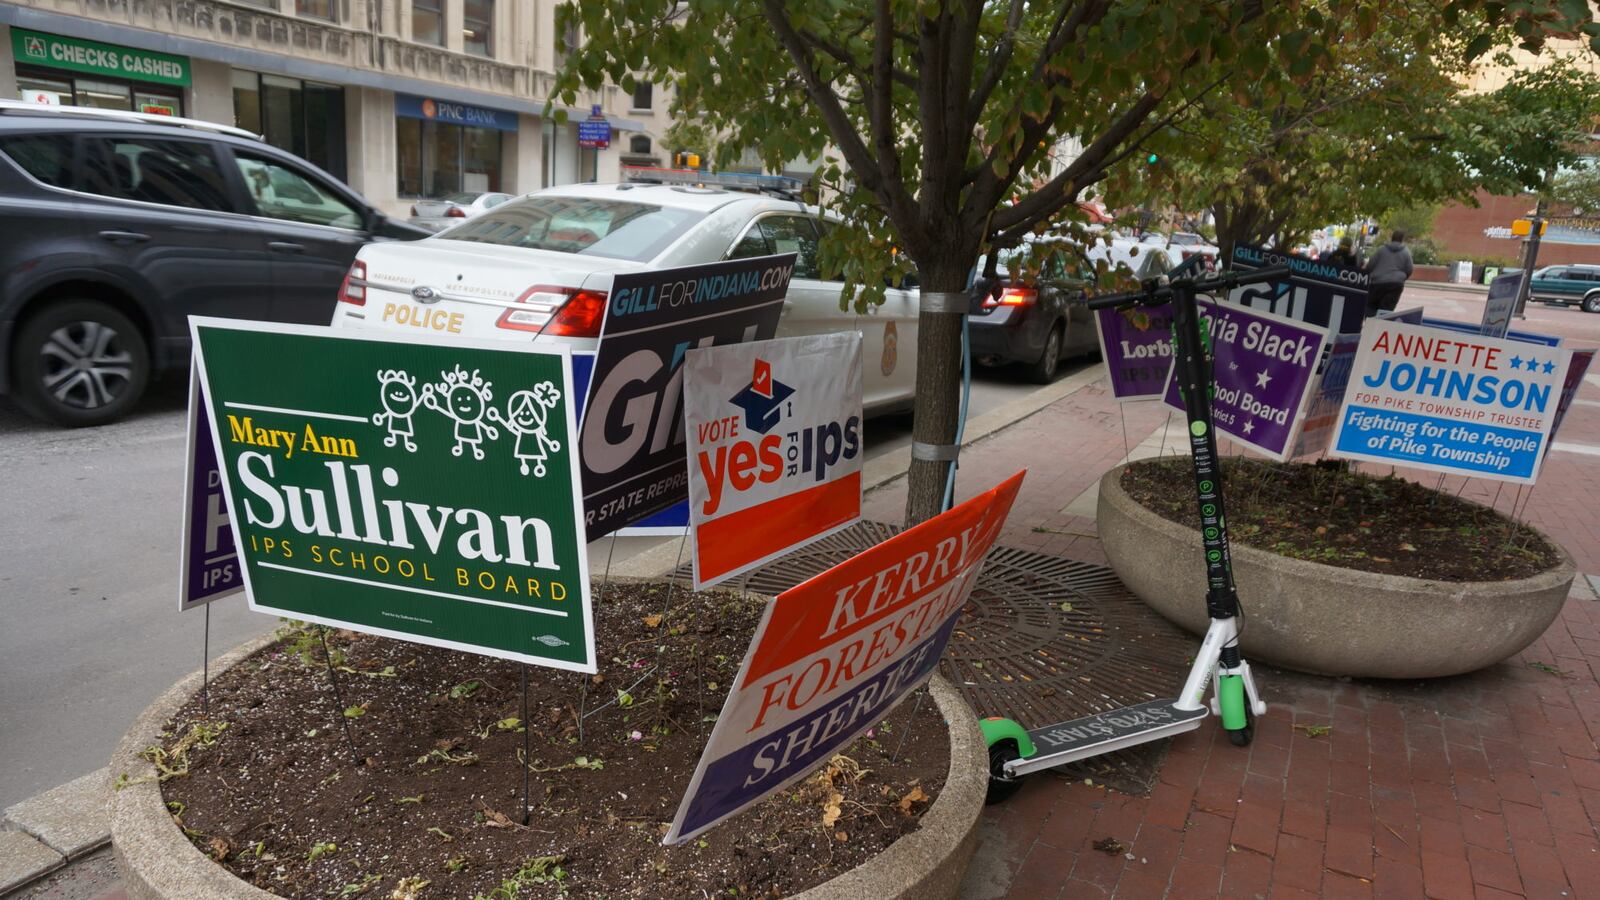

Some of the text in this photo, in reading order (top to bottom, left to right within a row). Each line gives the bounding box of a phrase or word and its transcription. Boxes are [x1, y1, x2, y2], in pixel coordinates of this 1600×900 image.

[51, 42, 183, 79] CHECKS CASHED
[438, 102, 497, 124] PNC BANK
[382, 303, 464, 334] POLICE
[1243, 321, 1313, 368] Slack
[1372, 331, 1502, 370] ANNETTE
[1214, 380, 1290, 425] hool Board
[1363, 360, 1551, 413] JOHNSON
[698, 415, 739, 445] VOTE
[1229, 414, 1236, 425] 5
[1348, 411, 1537, 453] Fighting for the People
[1355, 393, 1543, 430] FOR PIKE TOWNSHIP TRUSTEE
[226, 415, 359, 459] Mary Ann
[787, 431, 798, 478] FOR
[1367, 435, 1390, 450] of
[1389, 438, 1427, 455] Pike
[1430, 443, 1511, 470] Township
[698, 434, 784, 516] yes
[237, 451, 560, 571] Sullivan
[598, 488, 645, 521] STATE
[203, 564, 233, 589] IPS
[251, 535, 567, 601] IPS SCHOOL BOARD
[820, 518, 984, 639] KERRY
[744, 638, 936, 789] SHERIFF
